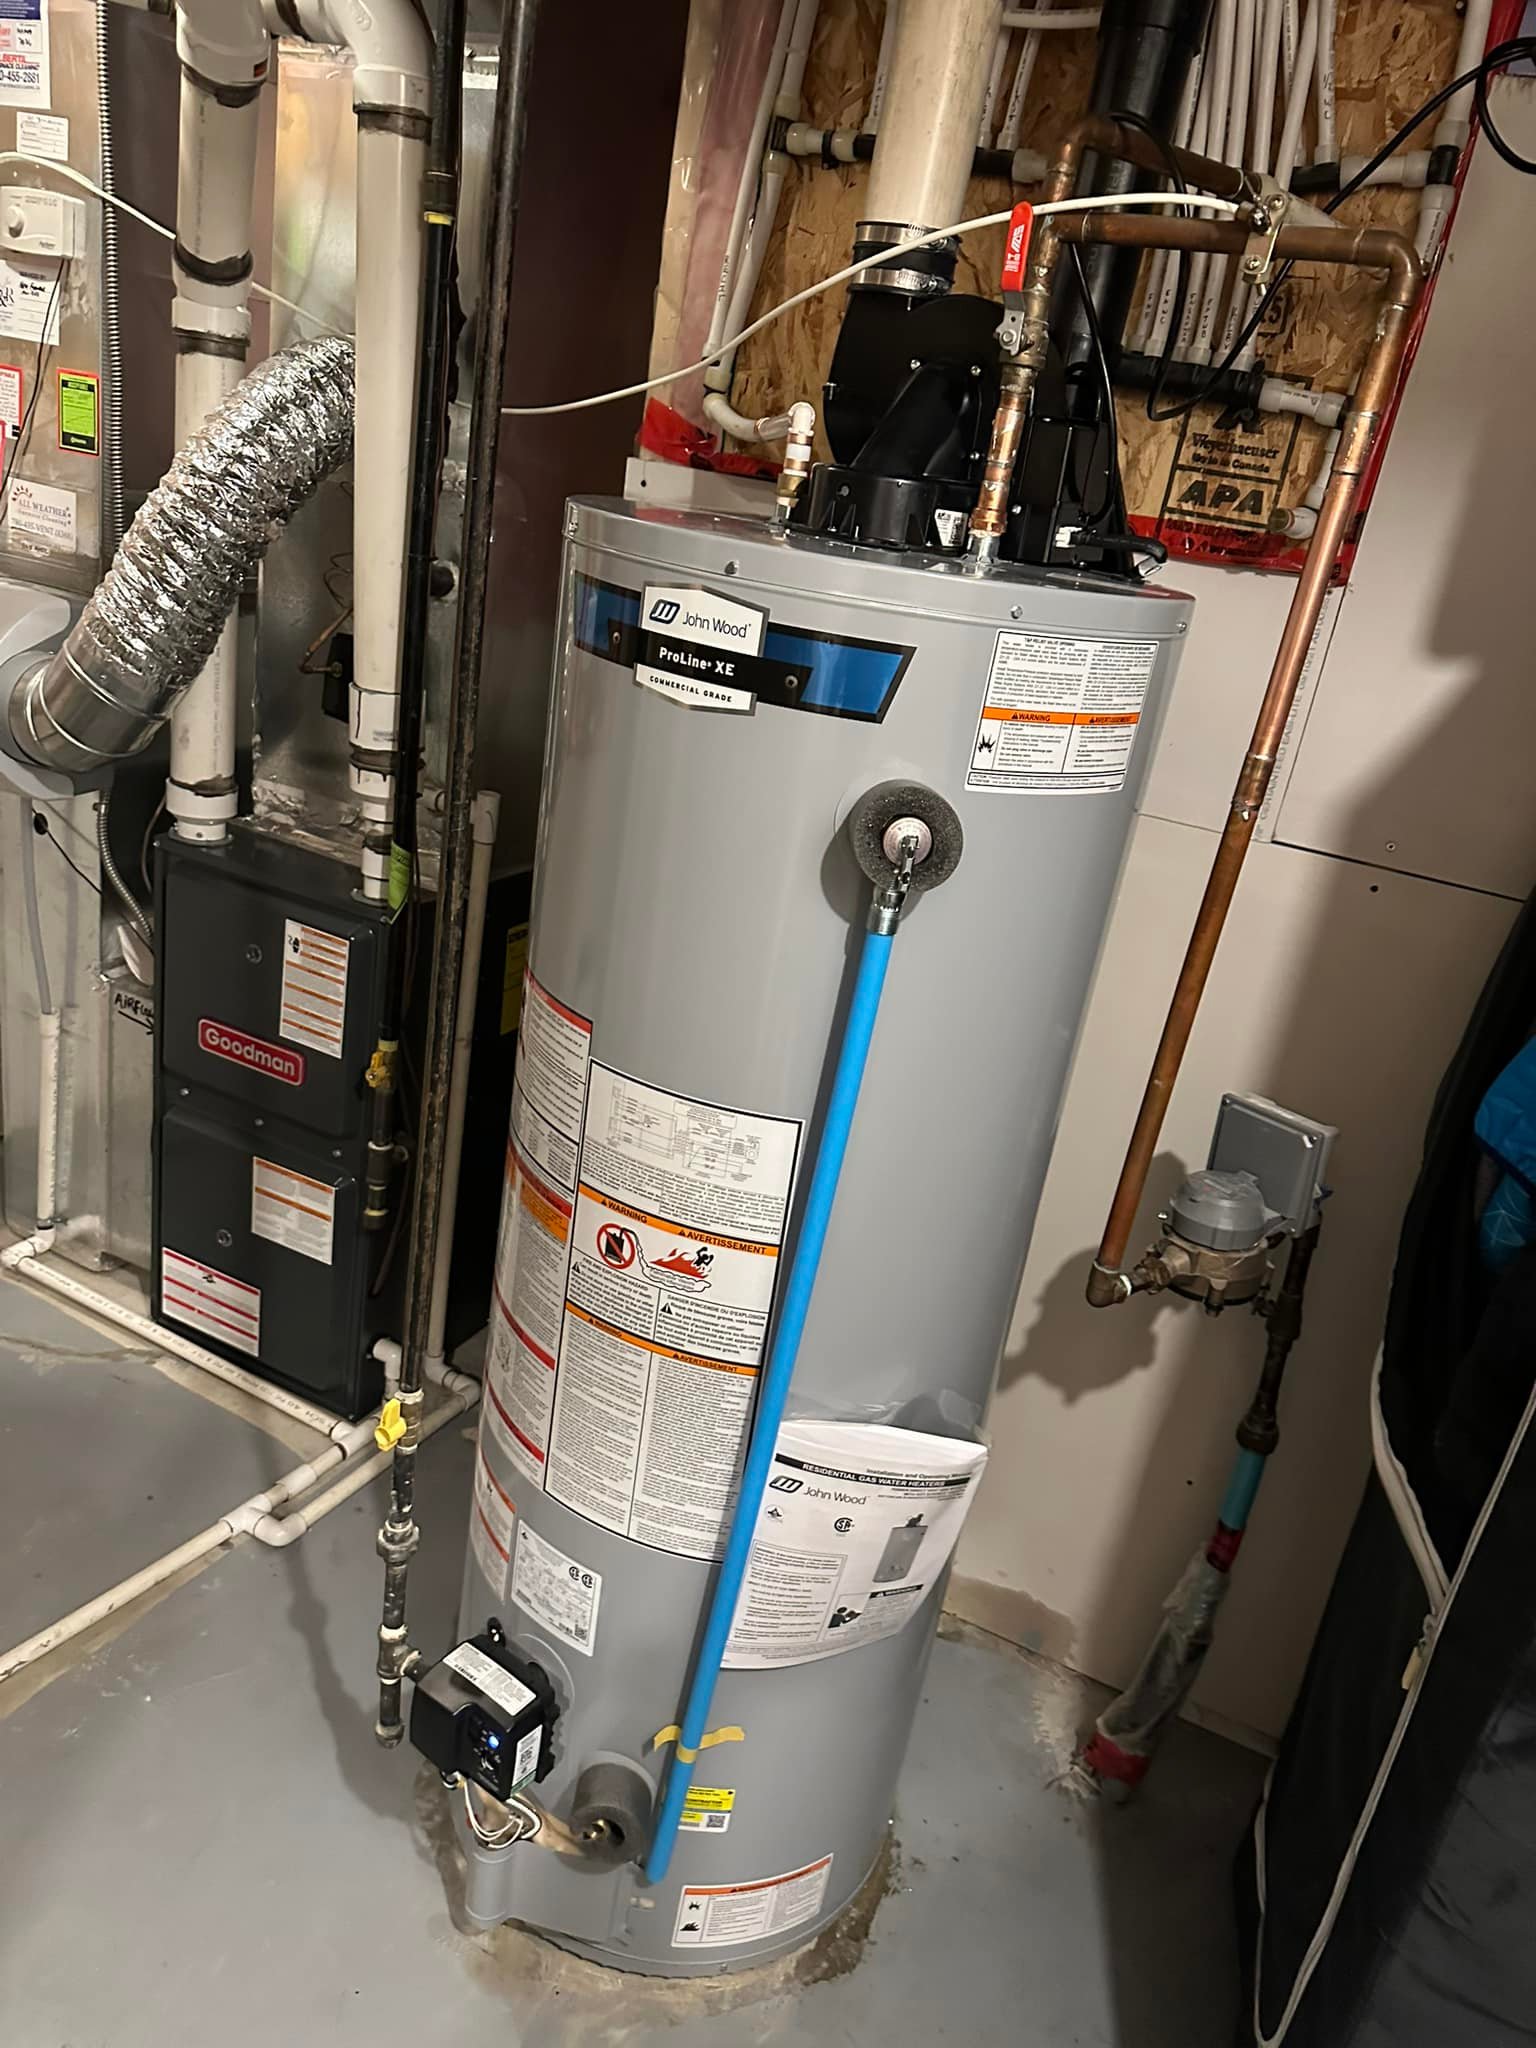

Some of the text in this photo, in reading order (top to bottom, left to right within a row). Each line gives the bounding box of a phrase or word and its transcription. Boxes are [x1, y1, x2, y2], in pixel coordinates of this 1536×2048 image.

[1192, 433, 1280, 460] Weyerhaeuser
[1232, 459, 1270, 473] Canada
[1176, 480, 1264, 515] APA
[682, 611, 710, 632] John
[712, 616, 747, 638] Wood
[714, 661, 736, 676] XE
[649, 675, 733, 702] COMMERCIAL GRADE
[1019, 714, 1050, 722] WARNING
[206, 1026, 294, 1078] Goodman
[608, 1200, 648, 1224] WARNING
[687, 1230, 768, 1256] AVERTISSEMENT
[679, 1354, 738, 1373] AVERTISSEMENT
[802, 1463, 946, 1488] RESIDENTIAL GAS WATER HEATERS
[803, 1486, 832, 1501] John
[833, 1492, 867, 1505] Wood
